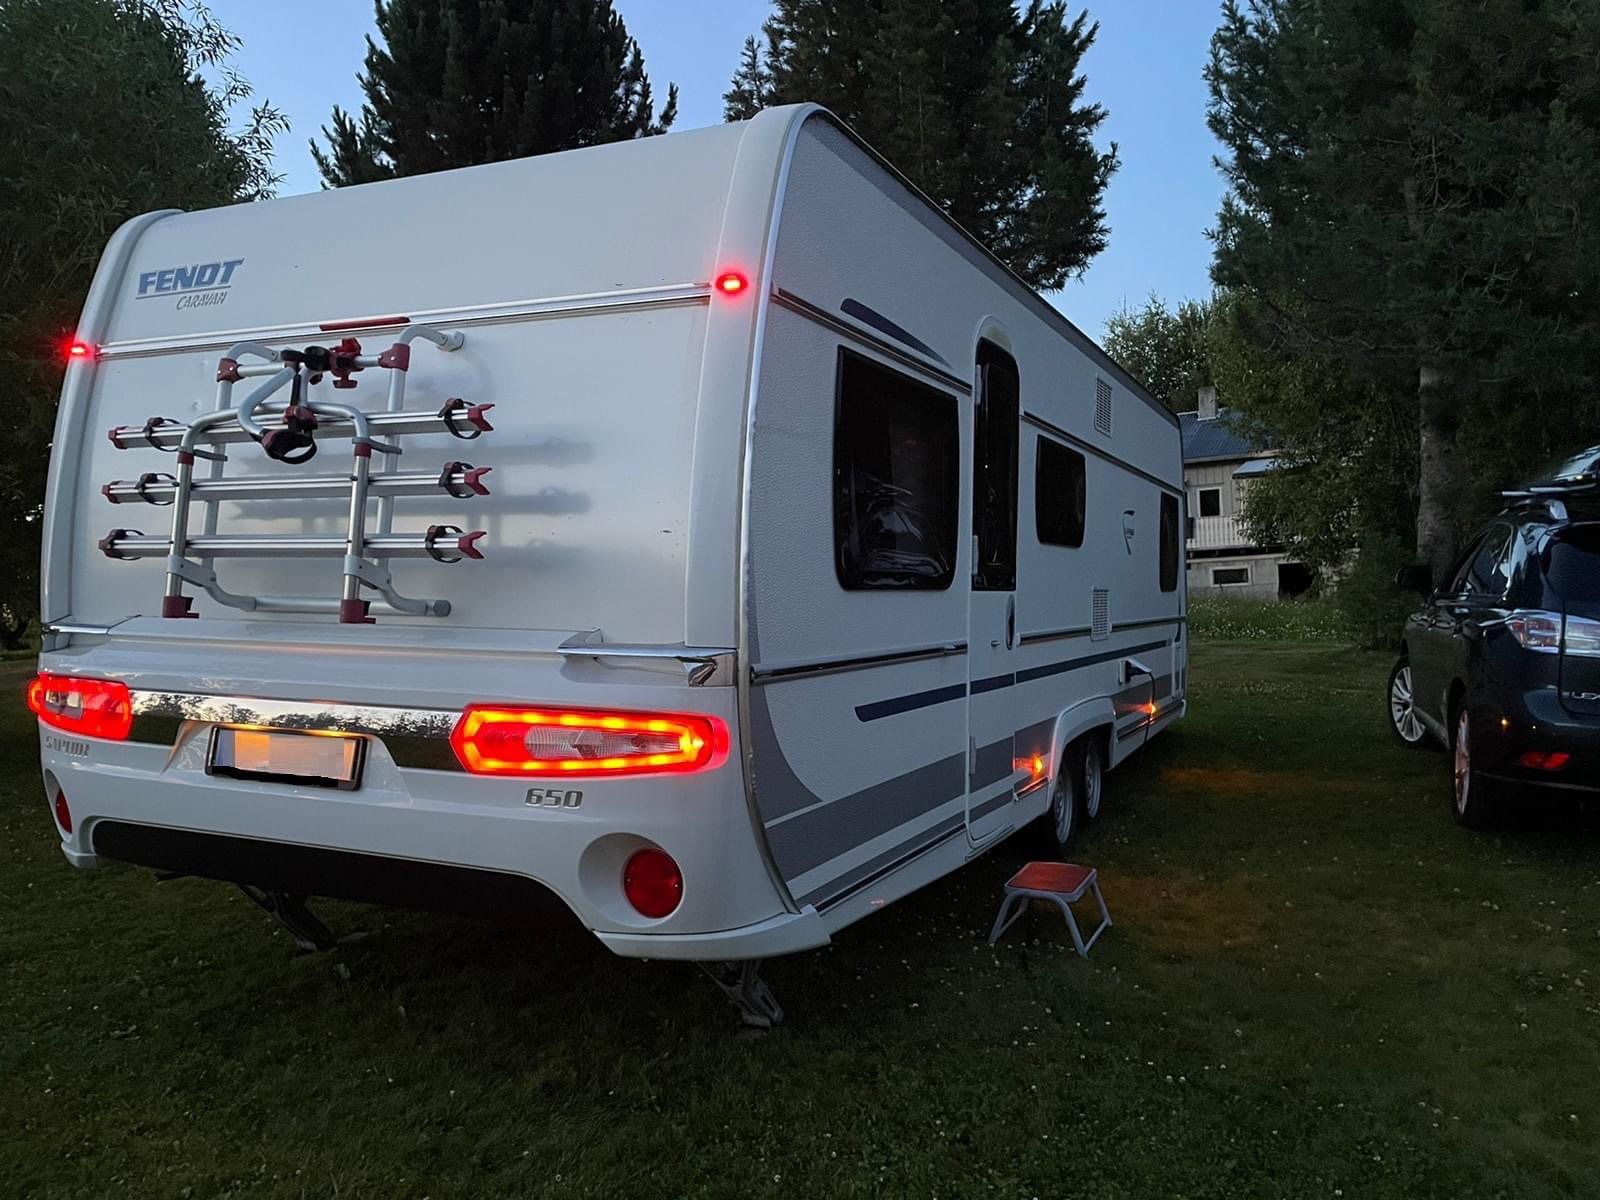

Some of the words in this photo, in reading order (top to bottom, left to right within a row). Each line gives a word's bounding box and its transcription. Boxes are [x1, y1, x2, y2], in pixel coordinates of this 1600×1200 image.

[138, 258, 244, 295] FENDT
[176, 291, 227, 310] CARAVAN
[525, 788, 583, 808] 650
